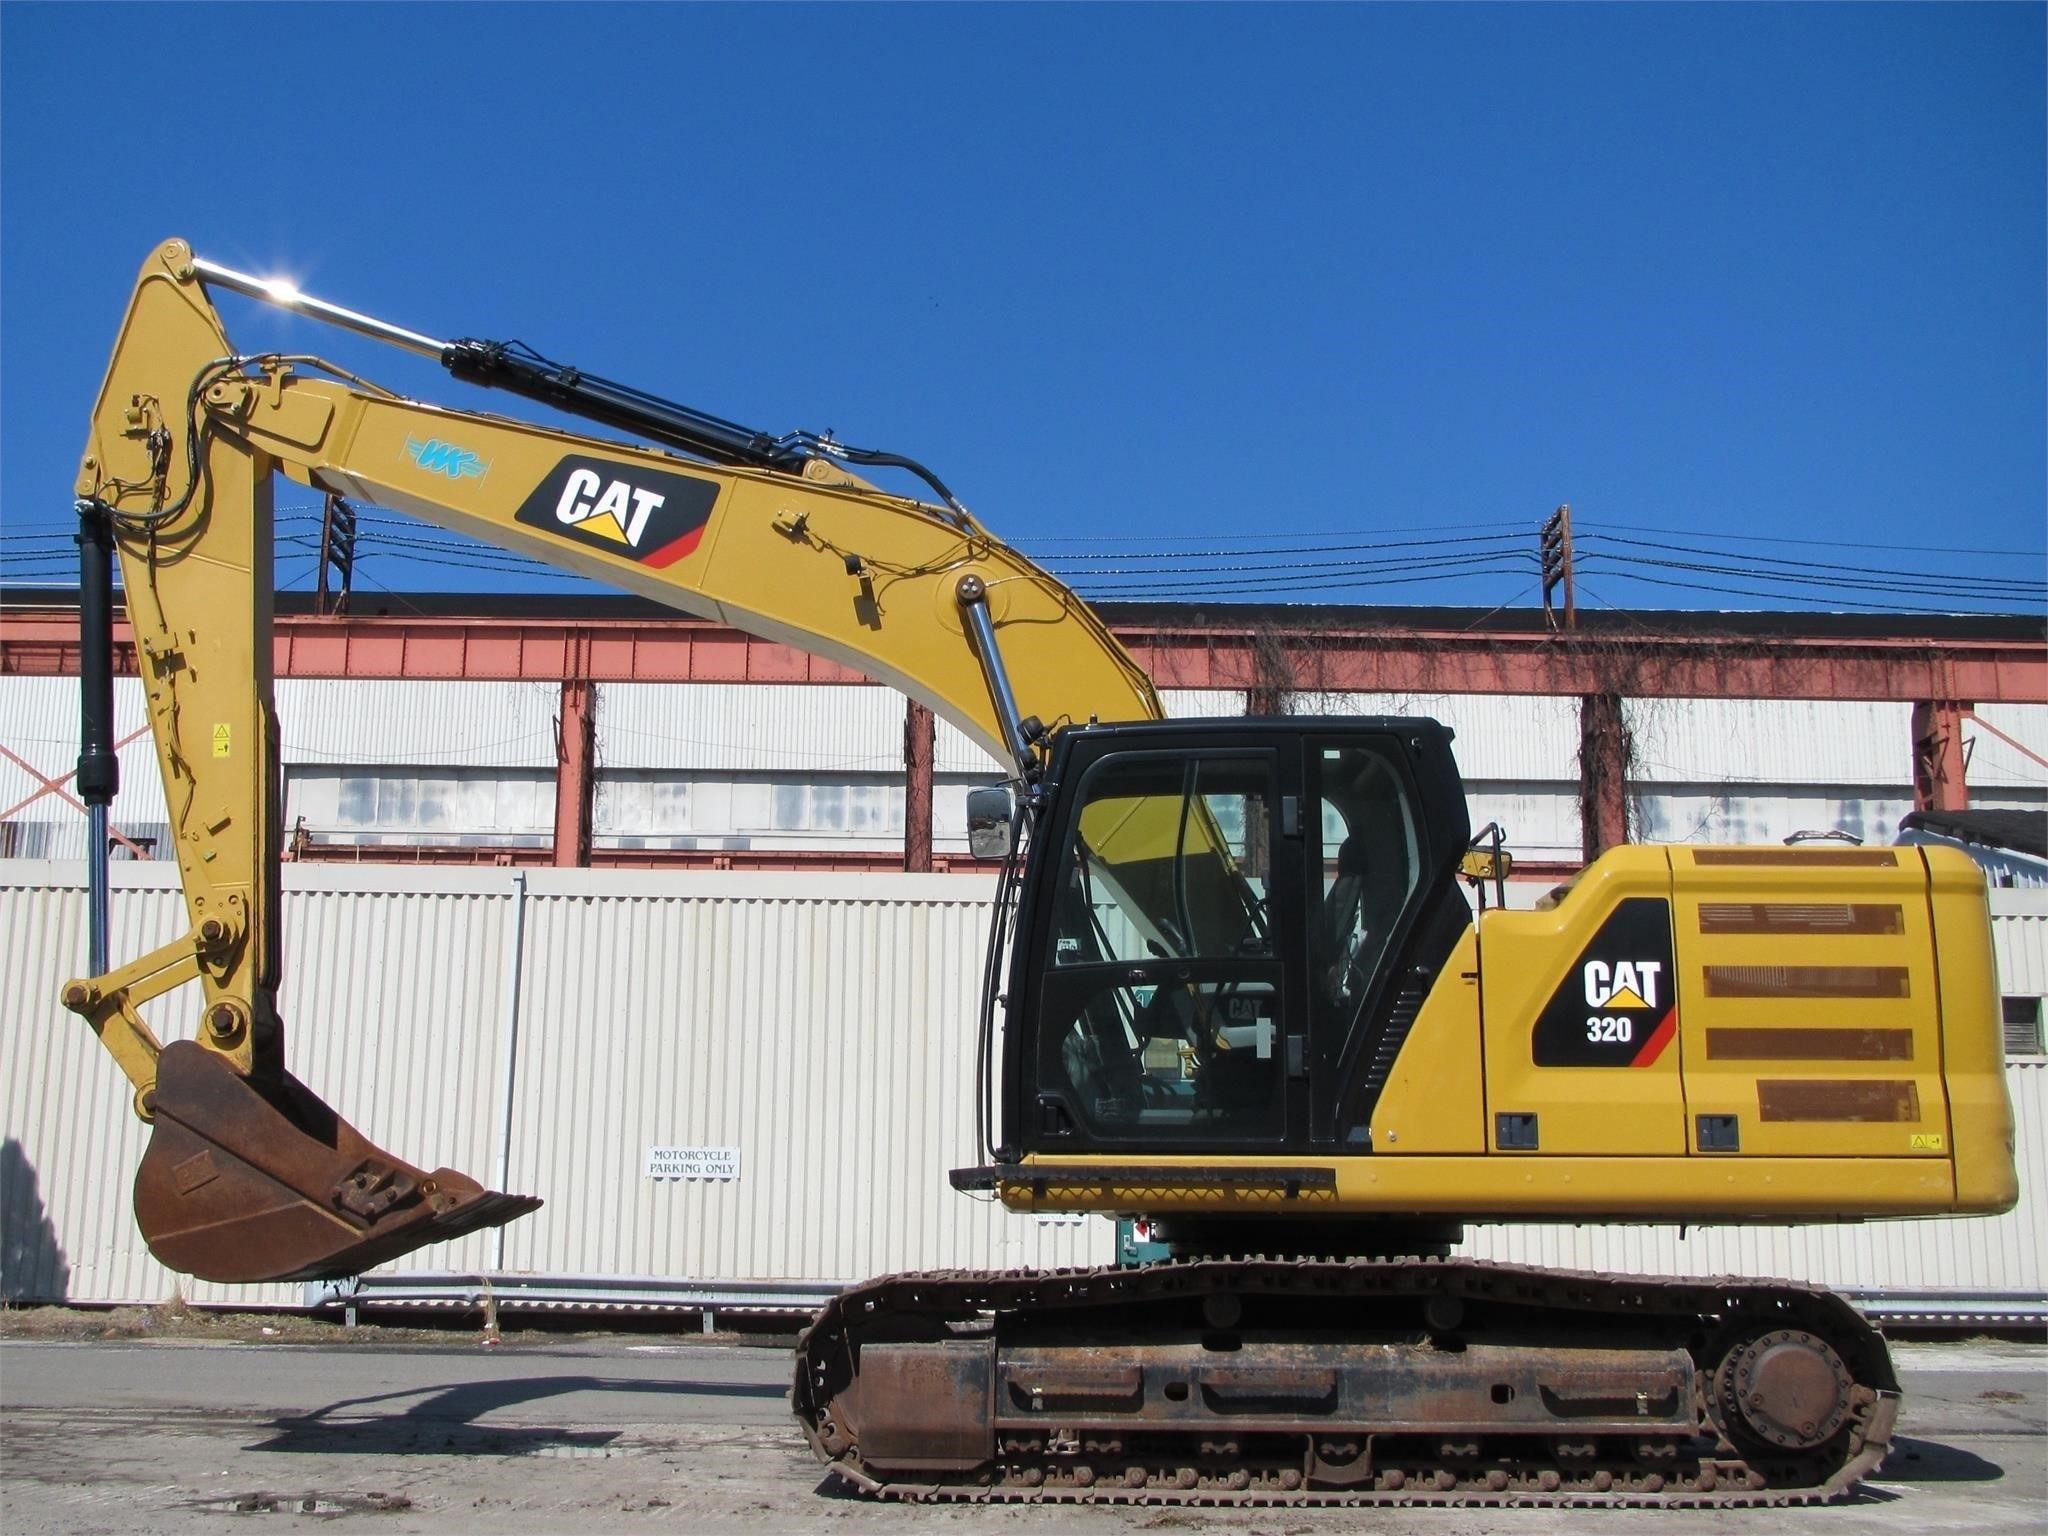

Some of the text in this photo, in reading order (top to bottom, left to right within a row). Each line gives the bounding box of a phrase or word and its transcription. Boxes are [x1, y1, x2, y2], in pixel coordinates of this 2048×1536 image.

[556, 468, 666, 548] CAT
[1584, 960, 1661, 1008] CAT
[1229, 998, 1263, 1020] CAT
[1586, 1017, 1632, 1042] 320
[654, 1150, 732, 1161] MOTORCYCLE
[650, 1163, 735, 1174] PARKING ONLY
